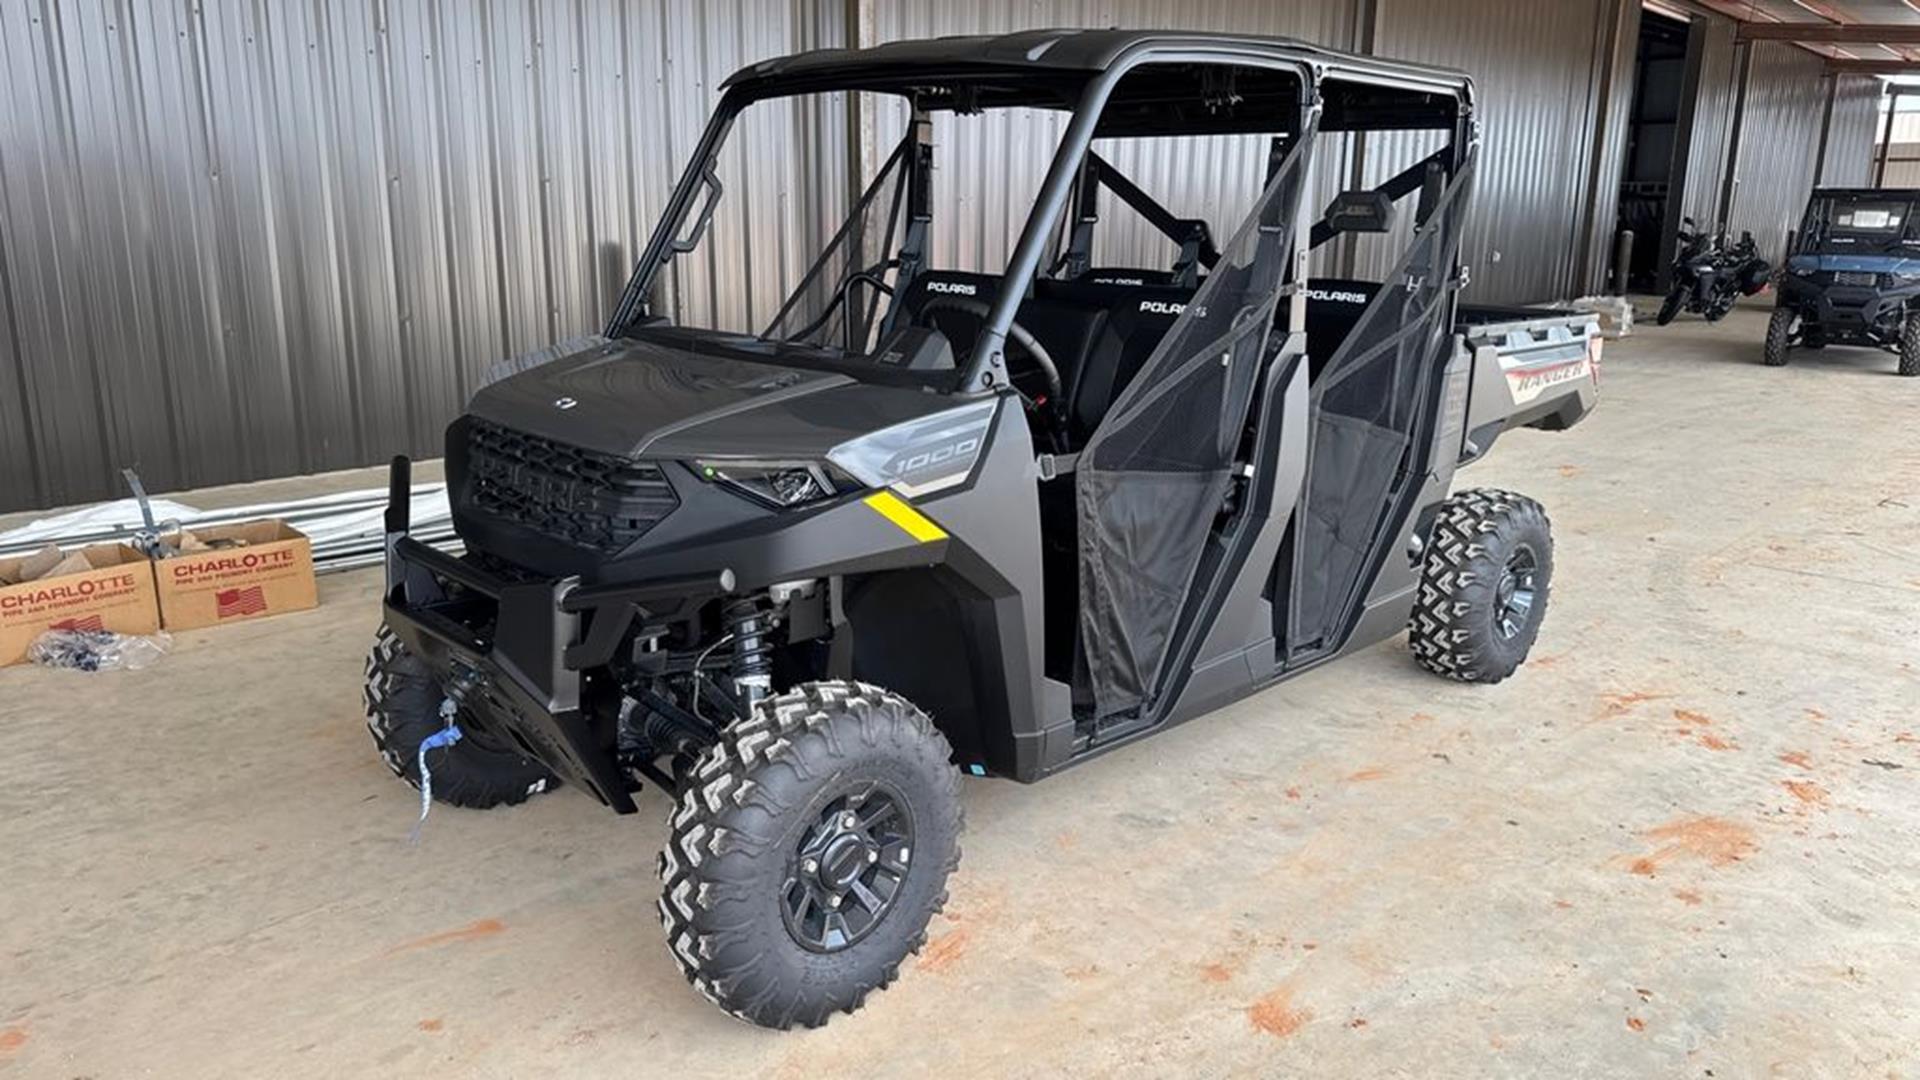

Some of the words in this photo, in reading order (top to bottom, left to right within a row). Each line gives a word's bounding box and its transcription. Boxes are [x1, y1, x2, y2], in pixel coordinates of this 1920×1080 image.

[927, 281, 976, 296] POLARIS
[1139, 301, 1207, 318] POLARS
[1516, 361, 1584, 392] RANGER
[896, 438, 978, 473] 1000
[174, 549, 294, 577] CHARLOTTE
[0, 573, 135, 609] CHARLOTTE
[48, 596, 90, 610] FOUNDRY
